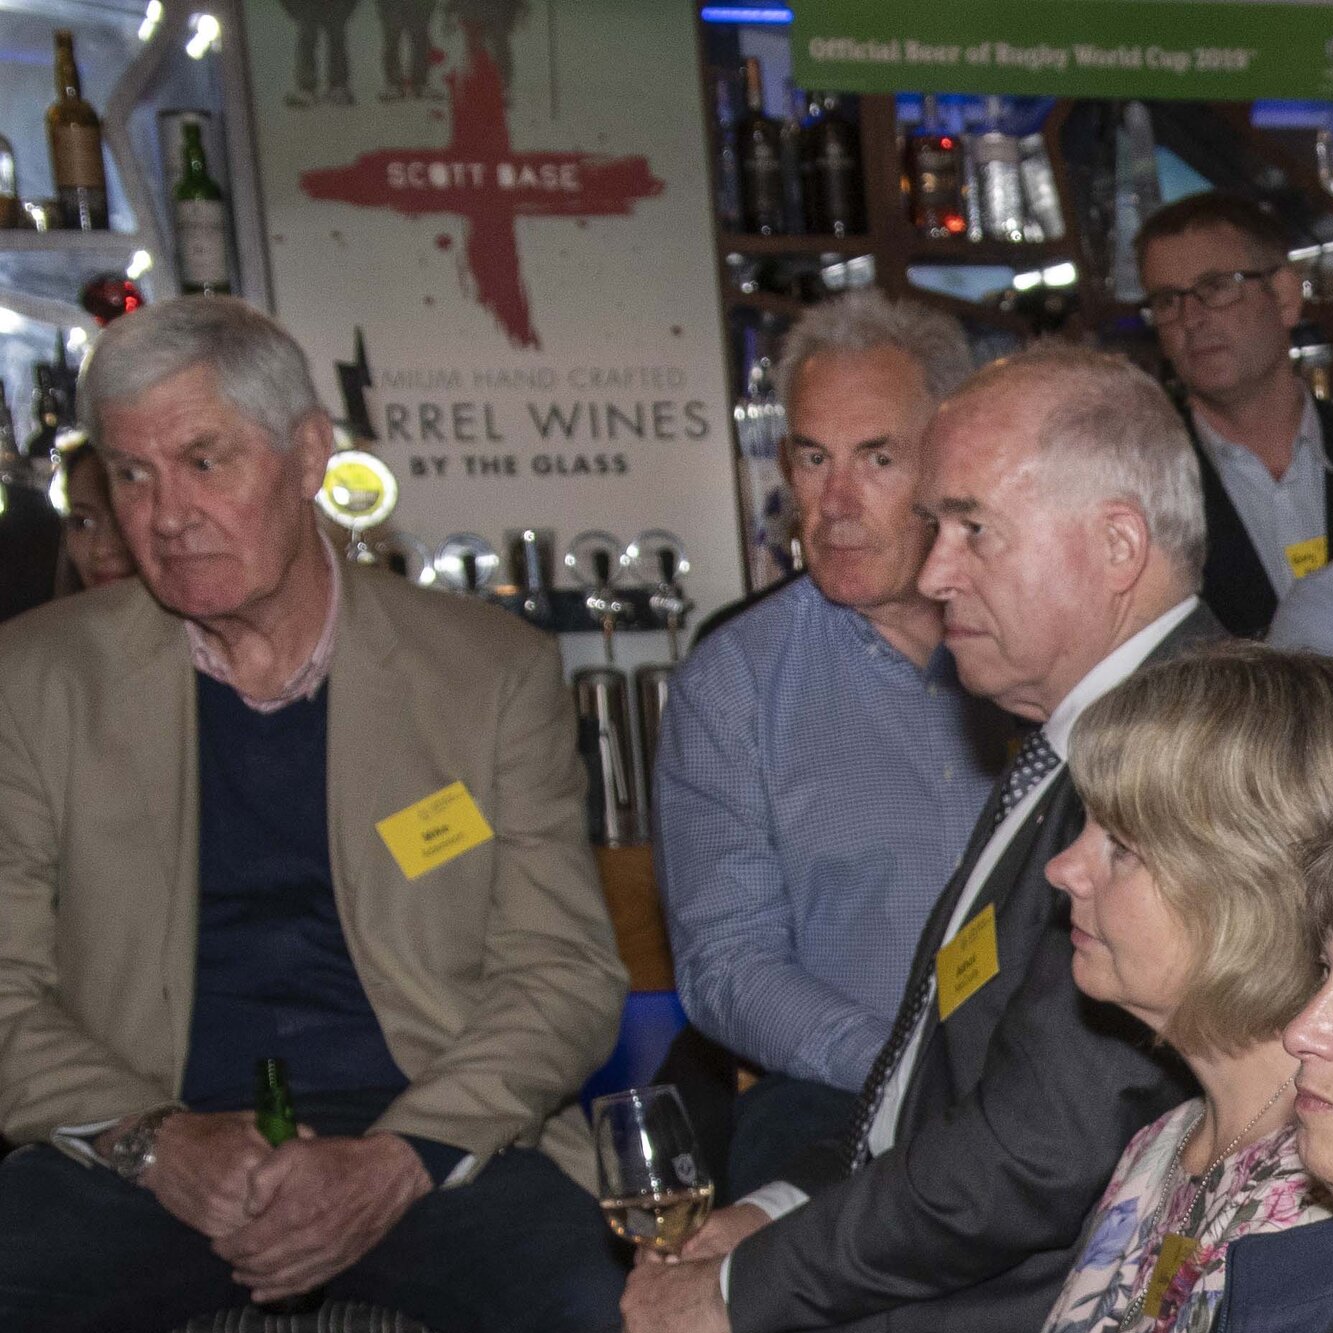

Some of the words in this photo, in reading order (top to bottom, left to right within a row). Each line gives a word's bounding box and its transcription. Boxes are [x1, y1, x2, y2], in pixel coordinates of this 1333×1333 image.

[810, 37, 899, 63] Official
[966, 41, 992, 64] of
[996, 42, 1068, 71] Rugby
[1072, 43, 1142, 69] World
[1145, 46, 1190, 75] Cup
[387, 161, 486, 189] SCOTT
[497, 163, 580, 191] BASE
[385, 402, 504, 442] RREL
[527, 400, 709, 441] WINES
[409, 455, 446, 477] BY
[463, 455, 517, 476] THE
[531, 454, 629, 476] GLASS
